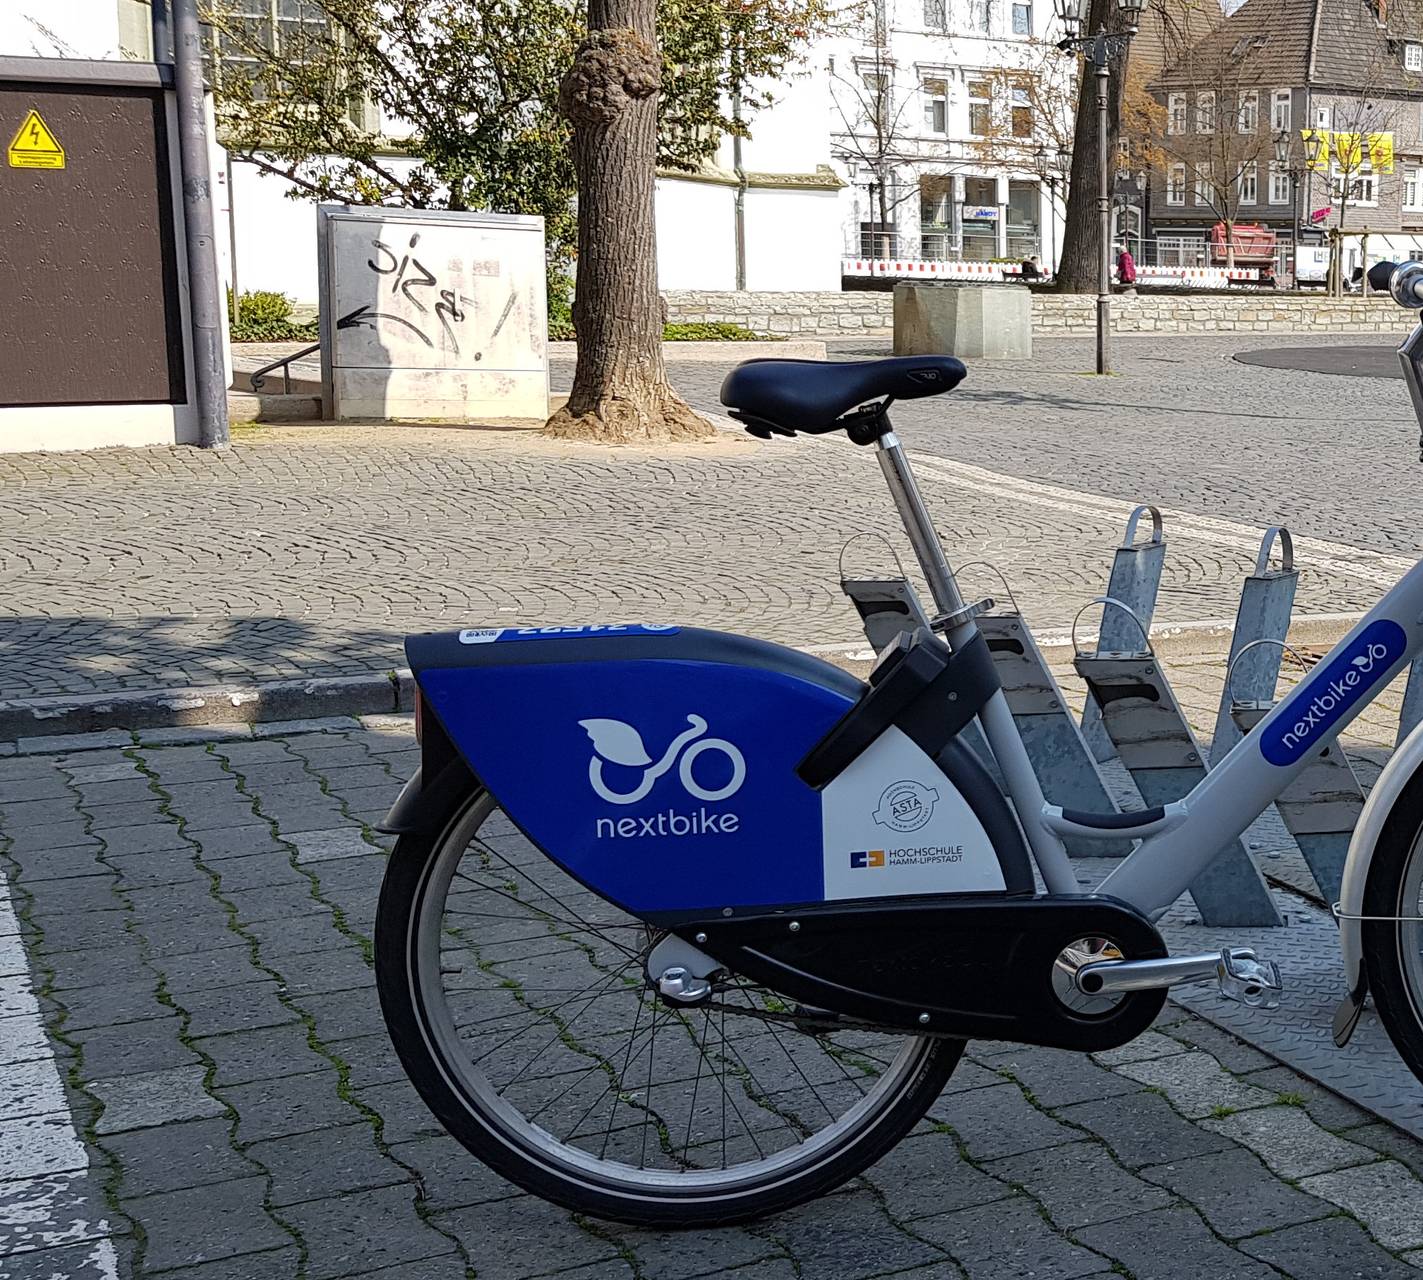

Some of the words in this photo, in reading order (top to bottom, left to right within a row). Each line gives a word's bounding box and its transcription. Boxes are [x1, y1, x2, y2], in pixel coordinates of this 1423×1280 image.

[1281, 668, 1361, 749] nextbike
[892, 798, 922, 816] ASTA
[596, 807, 740, 839] nextbike
[889, 845, 963, 858] HOCHSCHULE
[889, 854, 963, 866] HAMM-LIPPSTADT
